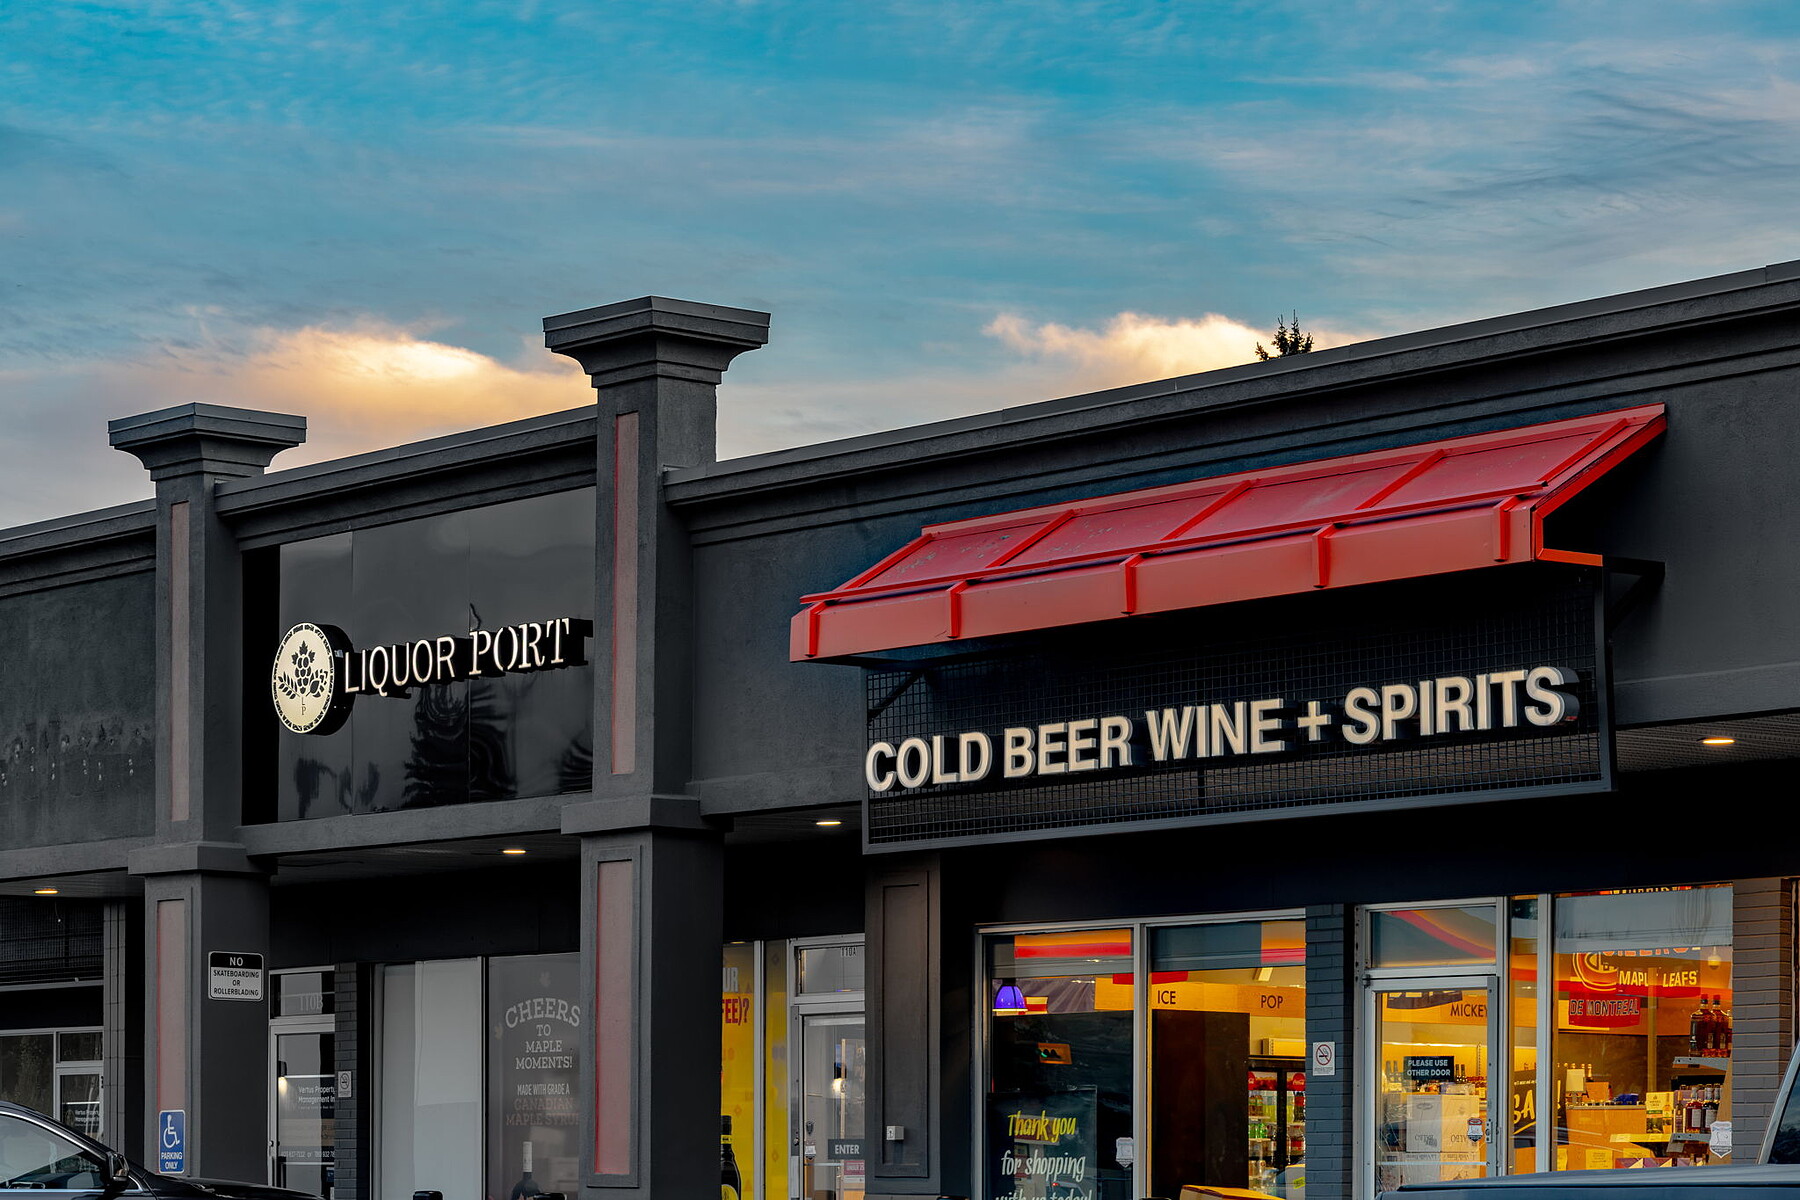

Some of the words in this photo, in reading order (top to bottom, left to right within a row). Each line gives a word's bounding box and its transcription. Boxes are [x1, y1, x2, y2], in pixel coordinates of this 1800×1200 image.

[344, 636, 456, 697] LIQUOR
[468, 617, 571, 676] PORT
[865, 731, 993, 792] COLD
[1003, 716, 1133, 778] BEER
[1145, 698, 1285, 761] WINE
[1297, 701, 1332, 741] +
[1342, 666, 1566, 744] SPIRITS
[229, 957, 244, 966] NO
[213, 970, 260, 978] SKATEBOARDING
[1619, 970, 1649, 986] MAPL
[1662, 970, 1697, 987] LEAFS
[213, 988, 259, 996] ROLLERBLADING
[1157, 990, 1176, 1004] ICE
[1260, 995, 1283, 1009] POP
[1570, 999, 1584, 1015] DE
[1586, 999, 1640, 1016] MONTREAL
[505, 997, 581, 1028] CHEERS
[721, 996, 750, 1026] EE)?
[536, 1024, 551, 1036] TO
[526, 1040, 562, 1053] MAPLE
[515, 1056, 573, 1069] MOMENTS!
[517, 1084, 532, 1095] MADE
[533, 1084, 547, 1095] WITH
[547, 1083, 564, 1095] GRADE
[565, 1083, 570, 1094] A
[513, 1098, 573, 1111] CANADIAN
[506, 1112, 544, 1126] MAPLE
[1007, 1110, 1049, 1141] Thank
[1051, 1117, 1077, 1143] you
[160, 1152, 183, 1160] PARKING
[834, 1144, 860, 1155] ENTER
[164, 1161, 179, 1169] ONLY
[1001, 1149, 1021, 1175] for
[1024, 1149, 1086, 1182] shopping
